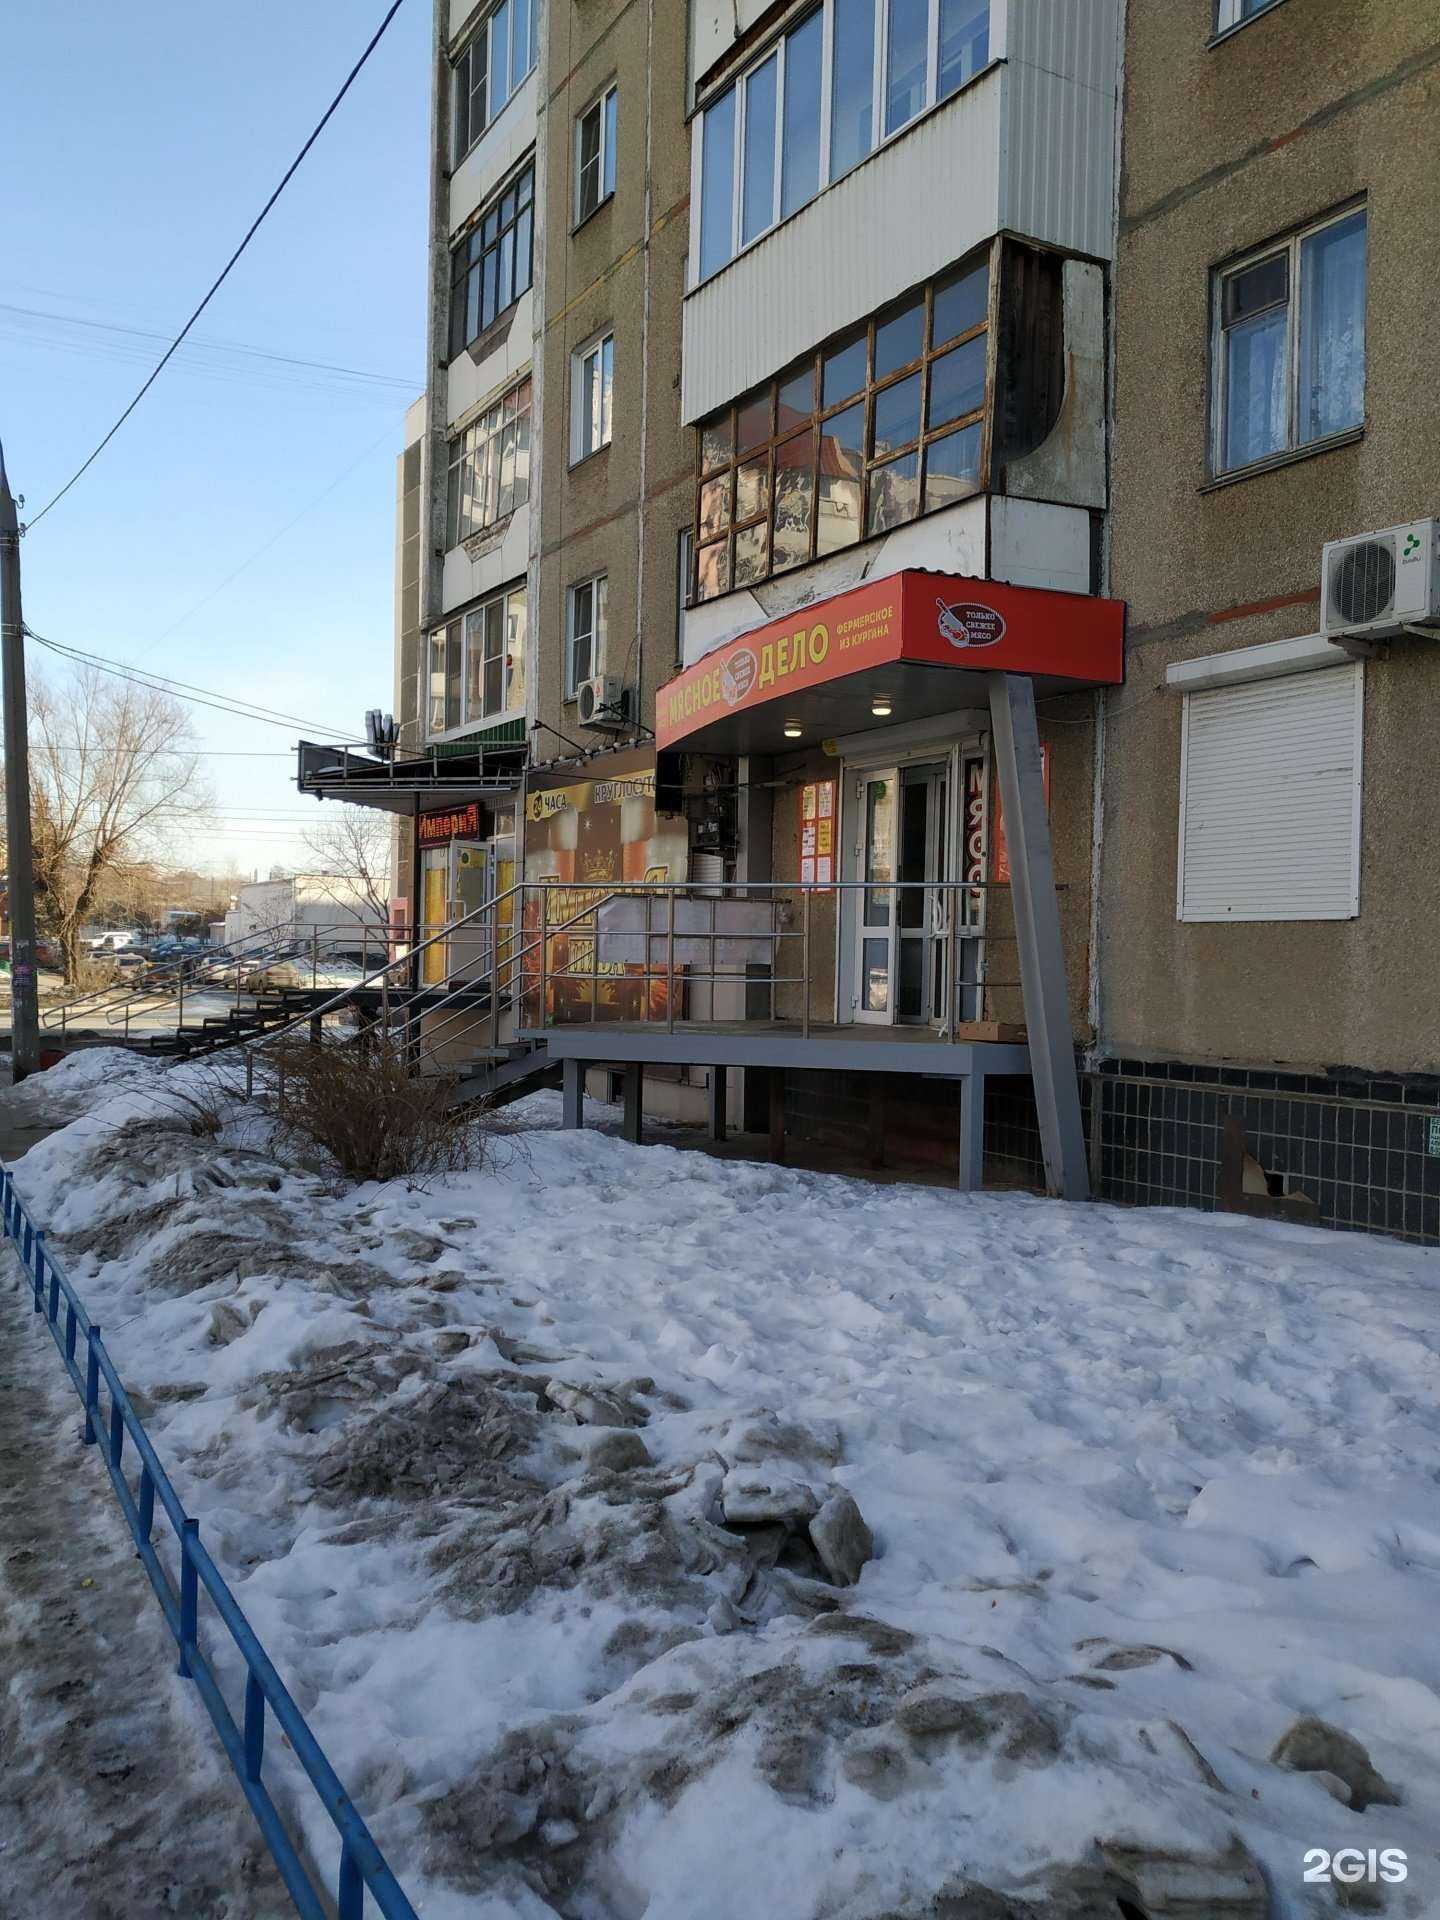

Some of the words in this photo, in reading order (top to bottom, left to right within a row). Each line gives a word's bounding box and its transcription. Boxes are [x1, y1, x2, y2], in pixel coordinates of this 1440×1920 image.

[836, 605, 893, 635] ФЕРМЕРСКОЕ
[965, 611, 996, 621] ТОЛЬКО
[966, 621, 996, 631] СВЕЖЕЕ
[838, 635, 851, 651] ИЗ
[851, 625, 889, 648] КУРГАНА
[970, 631, 993, 641] МЯСО
[669, 667, 721, 728] МЯСНОЕ
[758, 624, 830, 690] ДЕЛО
[544, 792, 568, 812] ЧАСА
